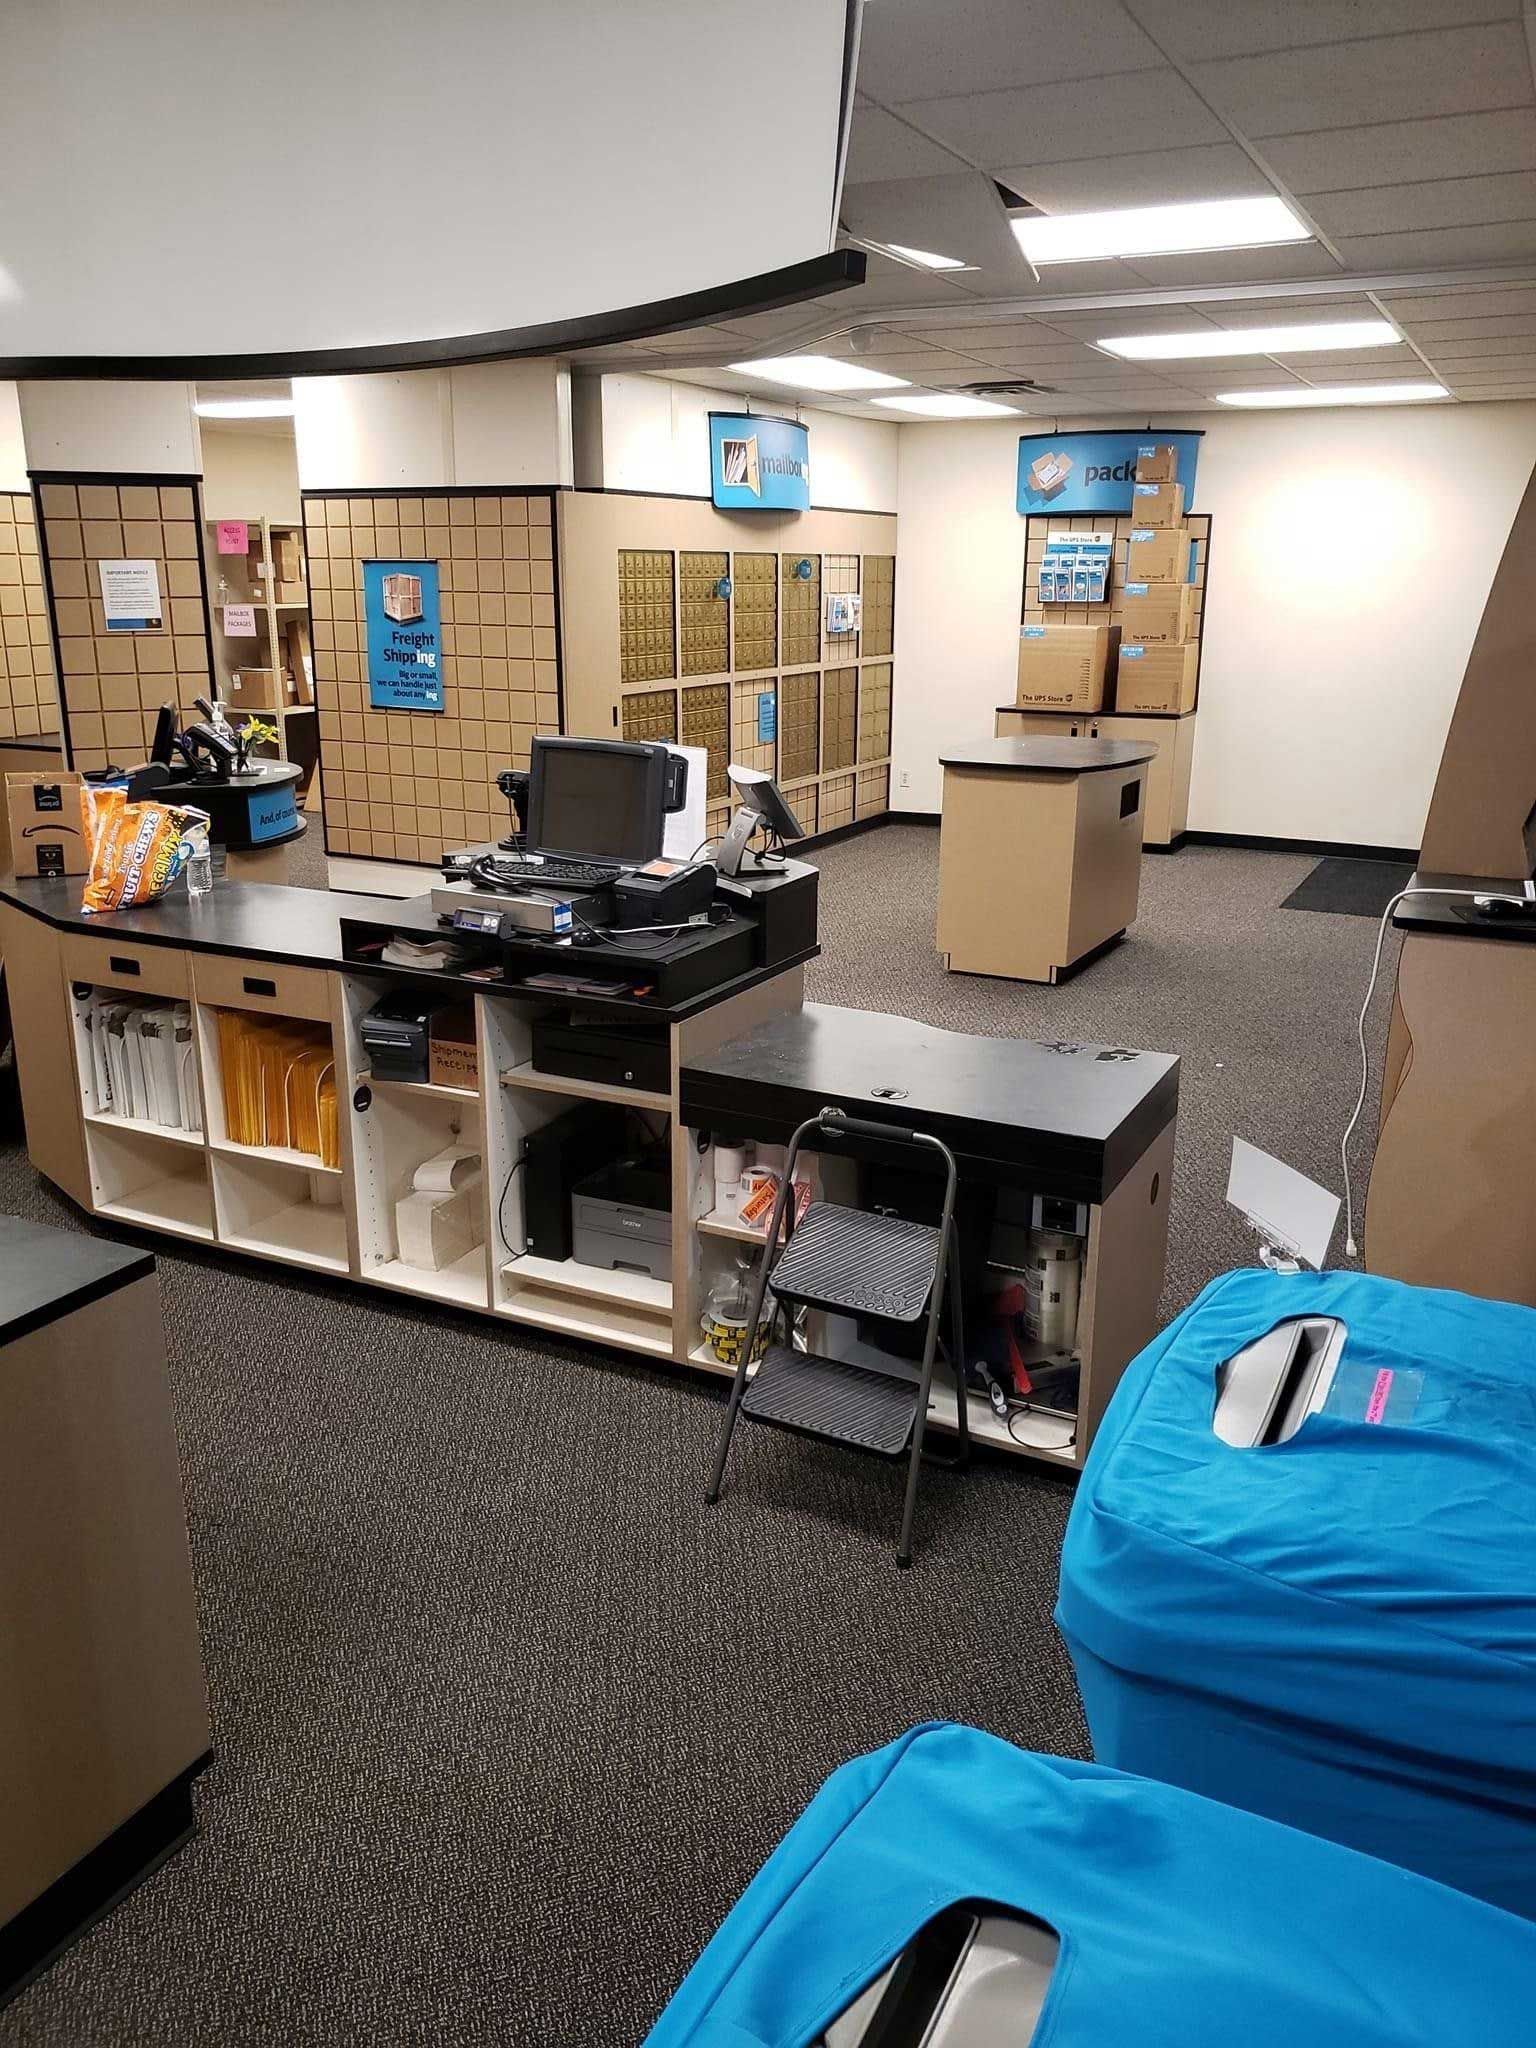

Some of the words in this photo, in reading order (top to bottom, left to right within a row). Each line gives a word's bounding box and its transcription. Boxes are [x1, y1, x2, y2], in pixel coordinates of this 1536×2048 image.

[392, 631, 435, 649] Freight
[383, 648, 436, 668] Shipping
[399, 670, 410, 680] Big
[393, 687, 413, 697] about
[400, 680, 424, 689] handle
[424, 682, 438, 690] just
[116, 865, 142, 910] FRUIT
[132, 810, 160, 865] CHEWS
